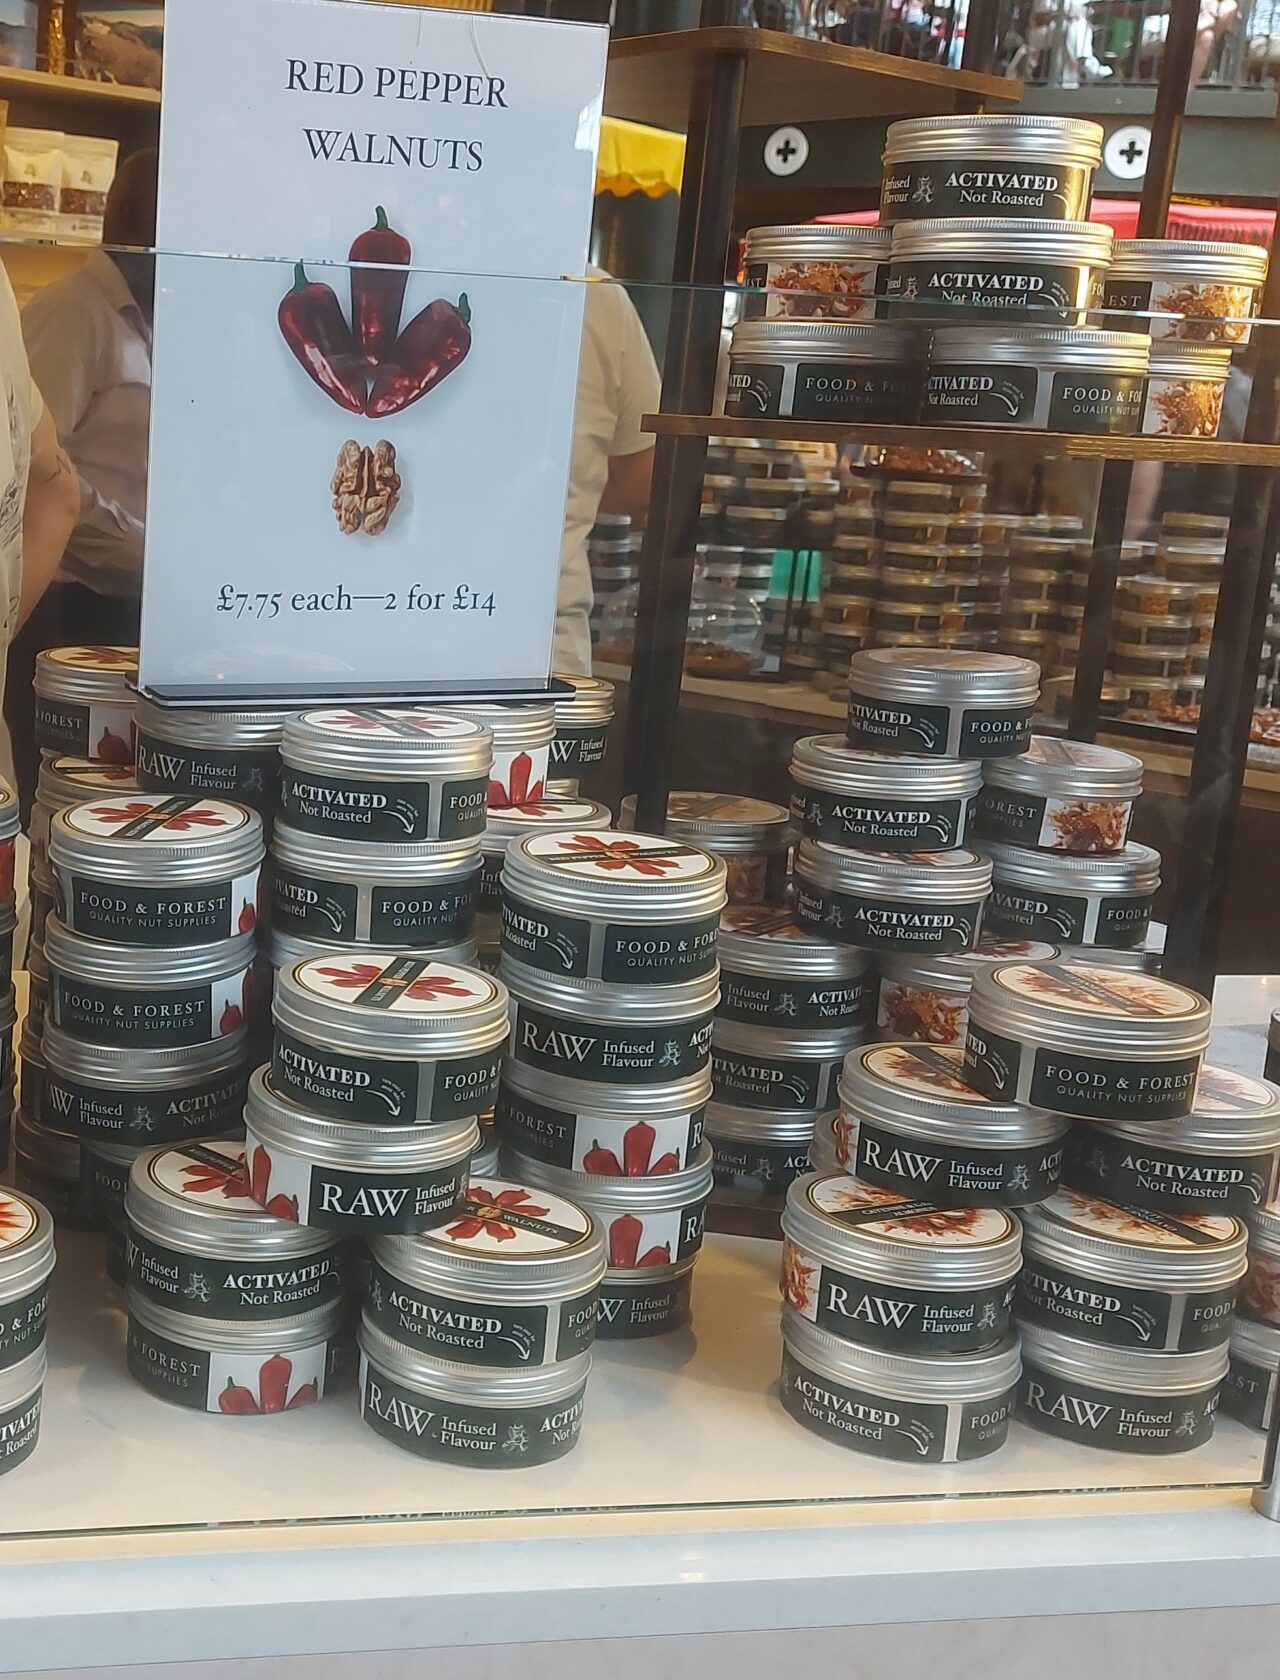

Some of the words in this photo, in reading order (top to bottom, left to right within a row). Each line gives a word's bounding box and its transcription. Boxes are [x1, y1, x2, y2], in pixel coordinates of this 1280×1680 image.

[284, 59, 363, 96] RED
[374, 66, 509, 109] PEPPER
[302, 128, 484, 172] WALNUTS
[945, 172, 1058, 192] ACTIVATED
[960, 190, 986, 204] Not
[991, 191, 1044, 207] Roasted
[928, 273, 1043, 291] ACTIVATED
[1063, 388, 1111, 401] FOOD
[216, 584, 283, 620] £7.75
[407, 585, 446, 613] for
[452, 585, 496, 617] £14
[971, 719, 1012, 733] FOOD
[190, 761, 236, 778] Infused
[190, 776, 236, 790] Flavour
[291, 781, 387, 809] ACTIVATED
[299, 800, 319, 817] Not
[322, 805, 371, 824] Roasted
[831, 805, 931, 824] ACTIVATED
[843, 820, 867, 835] Not
[870, 823, 918, 838] Roasted
[81, 893, 126, 912] FOOD
[135, 901, 147, 914] &
[157, 897, 226, 915] FOREST
[382, 900, 433, 914] FOOD
[89, 911, 134, 926] QUALITY
[138, 915, 162, 928] NUT
[167, 915, 216, 928] SUPPLIES
[854, 908, 954, 928] ACTIVATED
[867, 924, 892, 939] Not
[895, 926, 942, 941] Roasted
[616, 940, 671, 954] FOOD
[627, 955, 676, 967] QUALITY
[728, 984, 770, 1000] Infused
[134, 1000, 205, 1018] FOREST
[116, 1018, 138, 1029] NUT
[144, 1017, 194, 1030] SUPPLIES
[522, 1020, 597, 1063] RAW
[603, 1040, 654, 1054] Infused
[278, 1044, 371, 1087] ACTIVATED
[602, 1053, 654, 1067] Flavour
[444, 1069, 486, 1089] FOOD
[1045, 1065, 1106, 1087] FOOD
[303, 1072, 354, 1101] Roasted
[1056, 1085, 1111, 1102] QUALITY
[80, 1098, 123, 1116] Infused
[80, 1112, 124, 1129] Flavour
[863, 1138, 943, 1182] RAW
[949, 1160, 1003, 1178] Infused
[1121, 1155, 1244, 1183] ACTIVATED
[948, 1173, 1003, 1190] Flavour
[1136, 1175, 1165, 1192] Not
[1170, 1183, 1228, 1199] Roasted
[319, 1184, 410, 1218] RAW
[415, 1181, 455, 1203] Infused
[414, 1195, 455, 1224] Flavour
[504, 1213, 559, 1235] WALNUTS
[222, 1260, 330, 1290] ACTIVATED
[240, 1291, 269, 1306] Not
[272, 1281, 320, 1304] Roasted
[388, 1290, 502, 1335] ACTIVATED
[826, 1283, 919, 1330] RAW
[923, 1304, 974, 1319] Infused
[1046, 1299, 1103, 1326] Roasted
[399, 1313, 423, 1336] Not
[426, 1326, 484, 1349] Roasted
[921, 1318, 974, 1334] Flavour
[141, 1344, 201, 1376] FOREST
[368, 1382, 435, 1437] RAW
[794, 1376, 900, 1428] ACTIVATED
[1024, 1381, 1114, 1430] RAW
[827, 1410, 882, 1440] Roasted
[1119, 1408, 1172, 1423] Infused
[441, 1416, 497, 1436] Infused
[1117, 1422, 1171, 1438] Flavour
[440, 1431, 496, 1451] Flavour
